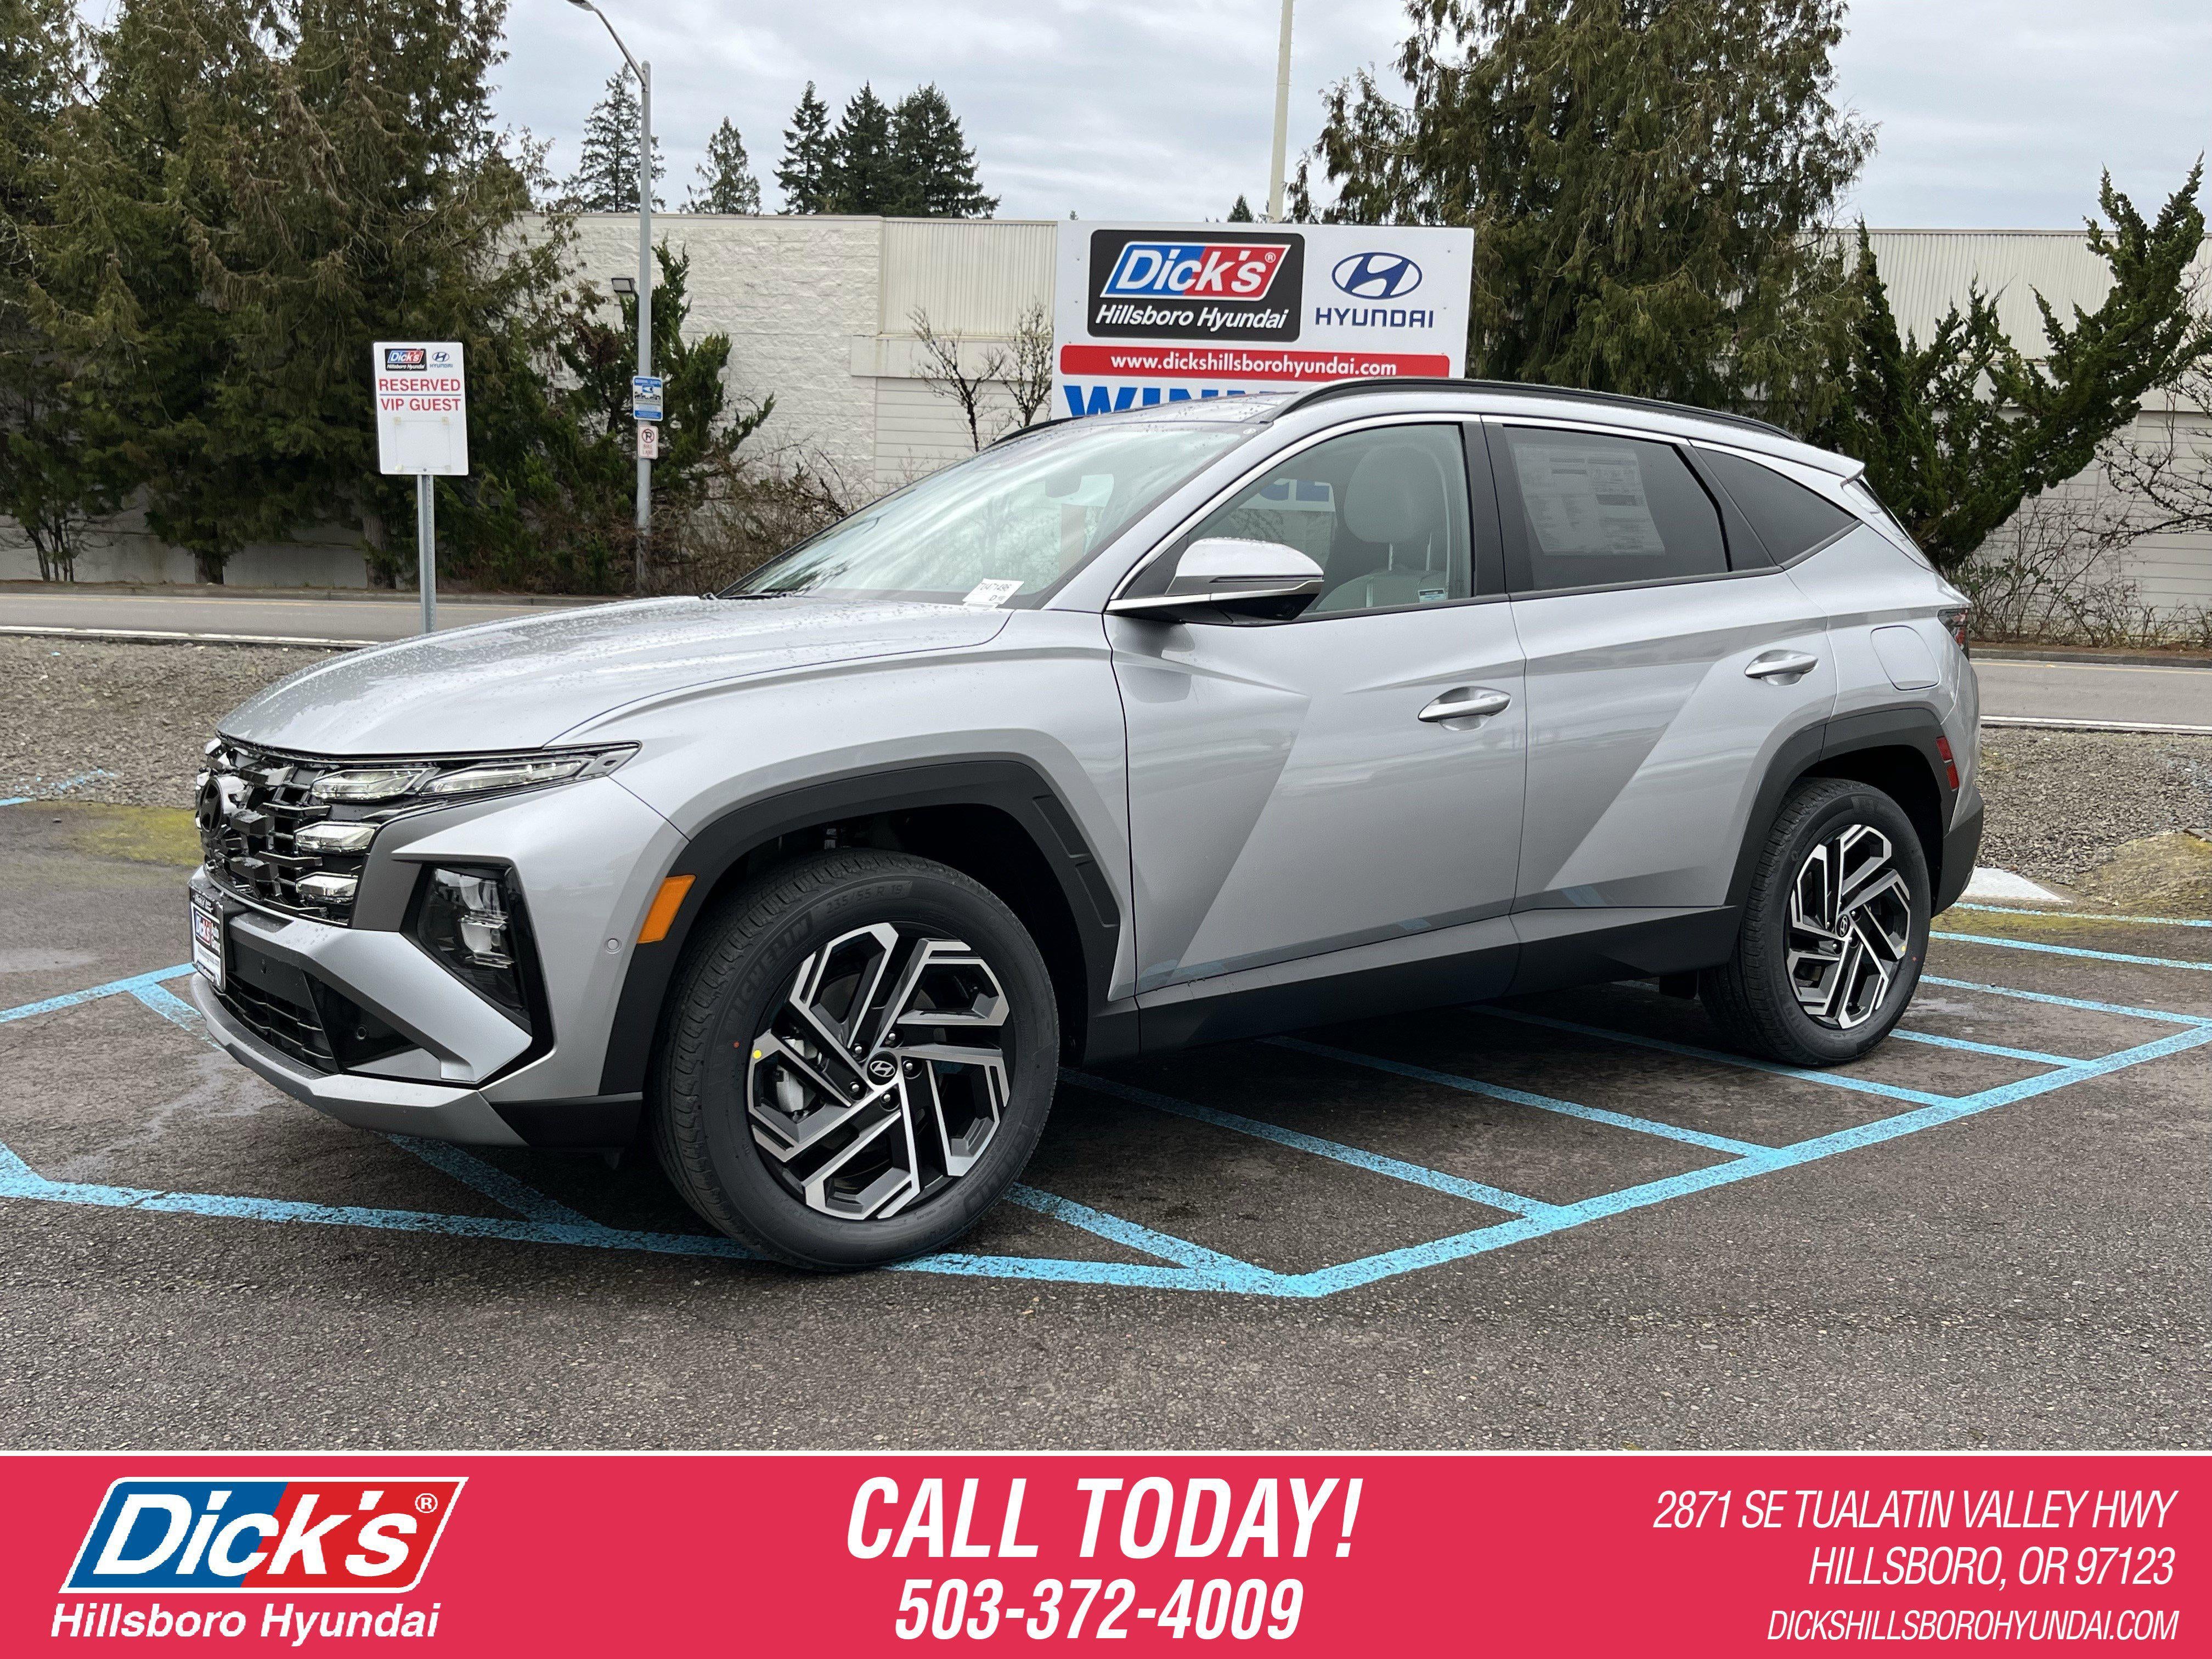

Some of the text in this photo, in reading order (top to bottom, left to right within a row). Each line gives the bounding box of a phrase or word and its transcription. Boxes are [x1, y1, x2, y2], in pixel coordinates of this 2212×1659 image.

[1096, 304, 1289, 332] Hillsboro Hyundai
[1316, 307, 1434, 328] HYUNDAI
[1111, 351, 1397, 378] www.dickshillsborohyundai.com
[379, 379, 461, 391] RESERVED
[381, 398, 461, 411] VIP GUEST
